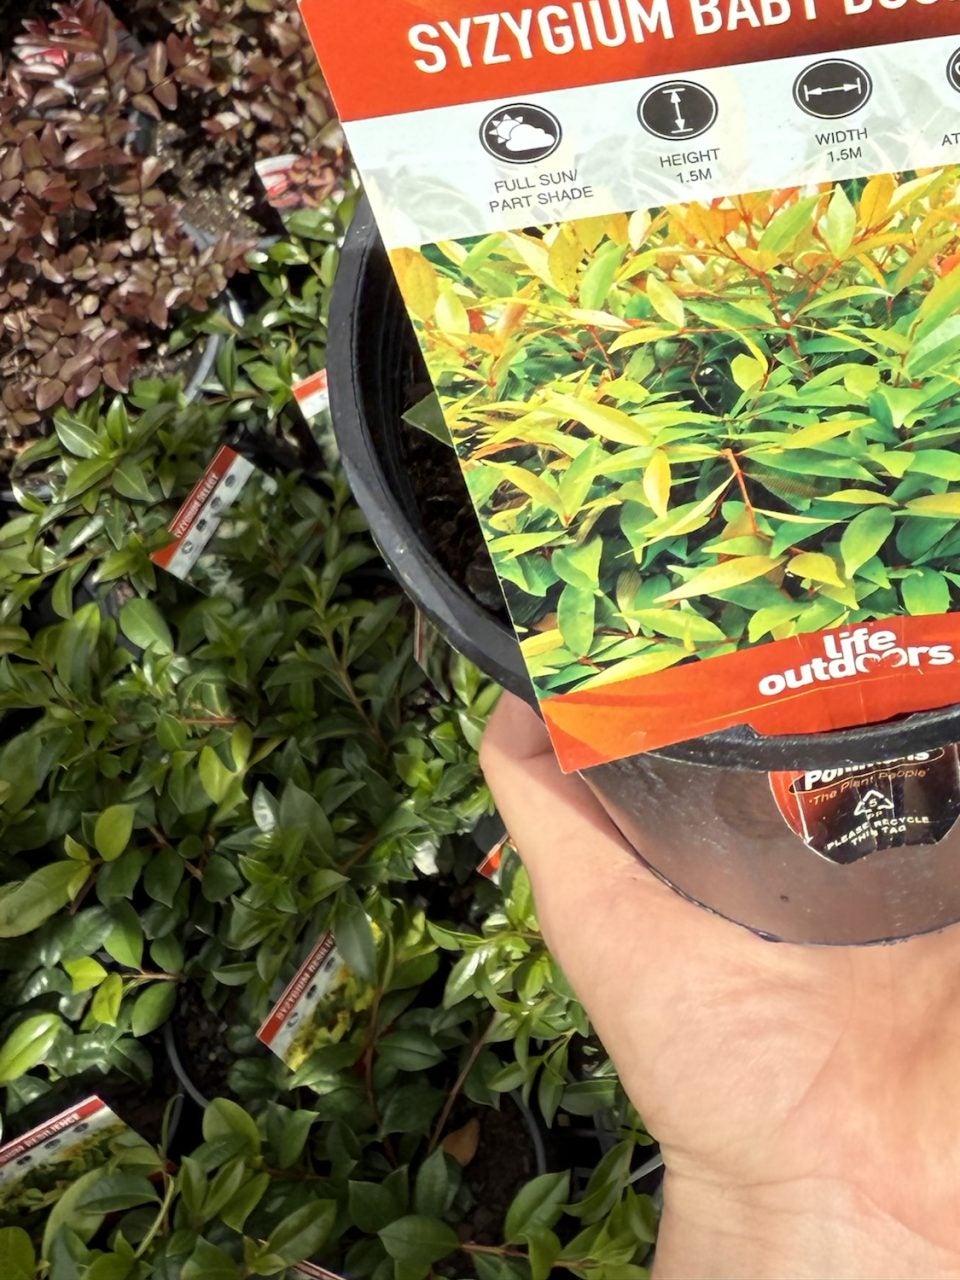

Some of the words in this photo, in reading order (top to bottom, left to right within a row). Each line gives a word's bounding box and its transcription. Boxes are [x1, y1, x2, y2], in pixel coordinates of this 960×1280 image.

[815, 127, 869, 146] WIDTH
[659, 147, 721, 169] HEIGHT
[827, 146, 863, 163] 1.5M
[494, 175, 537, 195] FULL
[538, 168, 579, 188] SUN/
[677, 168, 713, 185] 1.5M
[488, 194, 534, 214] PART
[537, 185, 595, 206] SHADE
[823, 627, 897, 660] life
[758, 644, 955, 697] outdoors
[840, 776, 874, 793] Plant
[827, 821, 870, 850] PLEASE
[873, 816, 930, 828] RECYCLE
[850, 829, 878, 847] THIS
[881, 825, 907, 835] TAG
